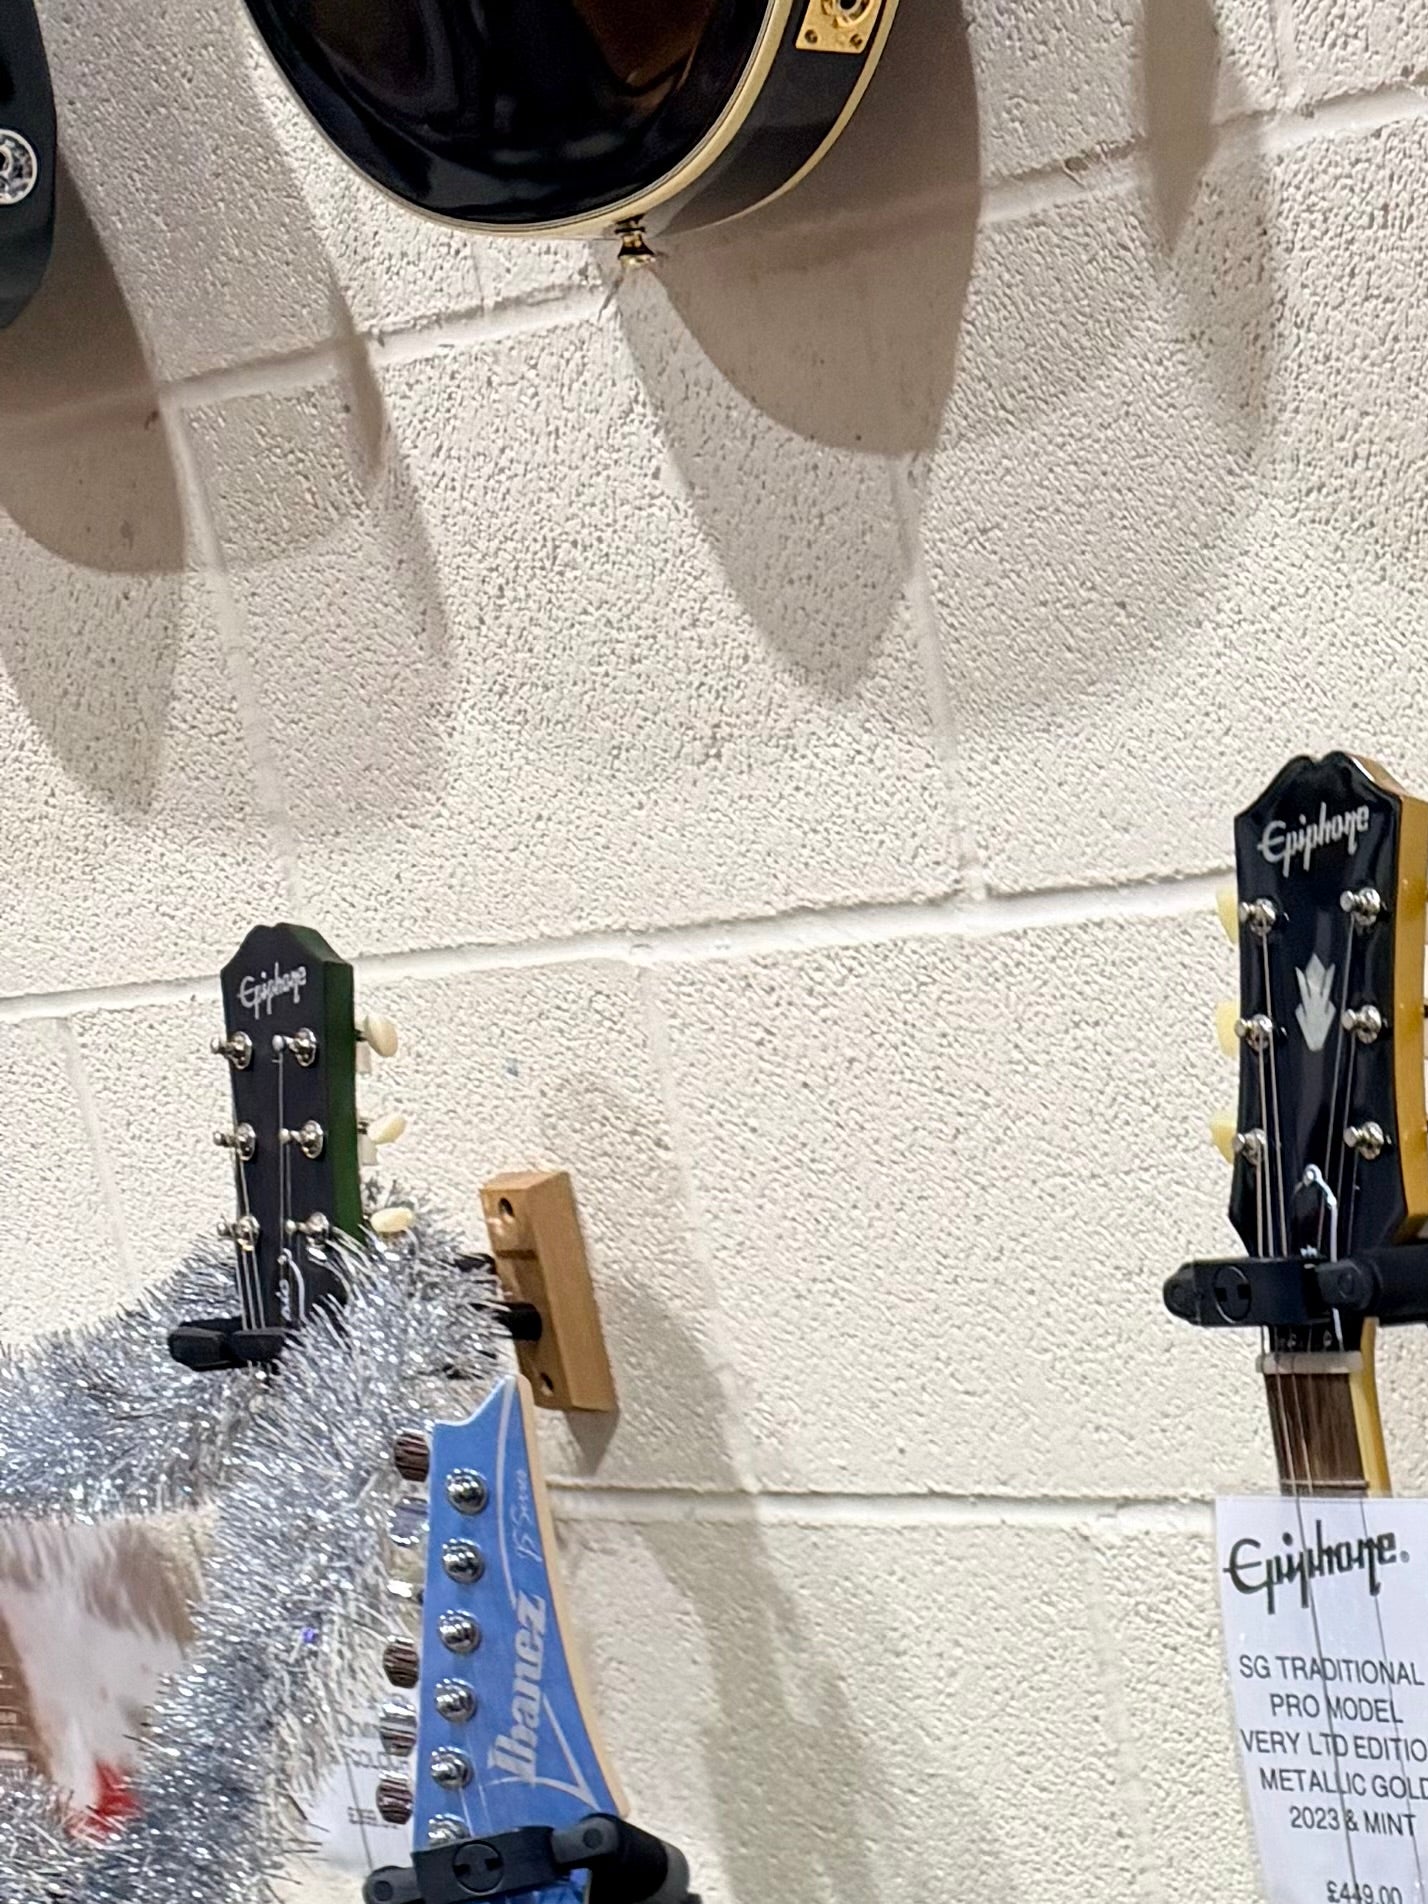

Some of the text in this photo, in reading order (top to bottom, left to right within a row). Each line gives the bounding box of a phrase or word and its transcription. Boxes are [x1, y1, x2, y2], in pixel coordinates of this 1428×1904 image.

[1257, 801, 1370, 878] Epiphone
[236, 961, 307, 1020] Epiphone
[1240, 1655, 1425, 1686] SG TRADITIONAL
[487, 1590, 547, 1788] Ibanez
[1270, 1693, 1404, 1725] PRO MODEL
[1241, 1729, 1300, 1754] VERY
[1308, 1733, 1349, 1758] LTD
[1260, 1767, 1367, 1797] METALLIC
[1289, 1806, 1416, 1838] 2023 & MINT
